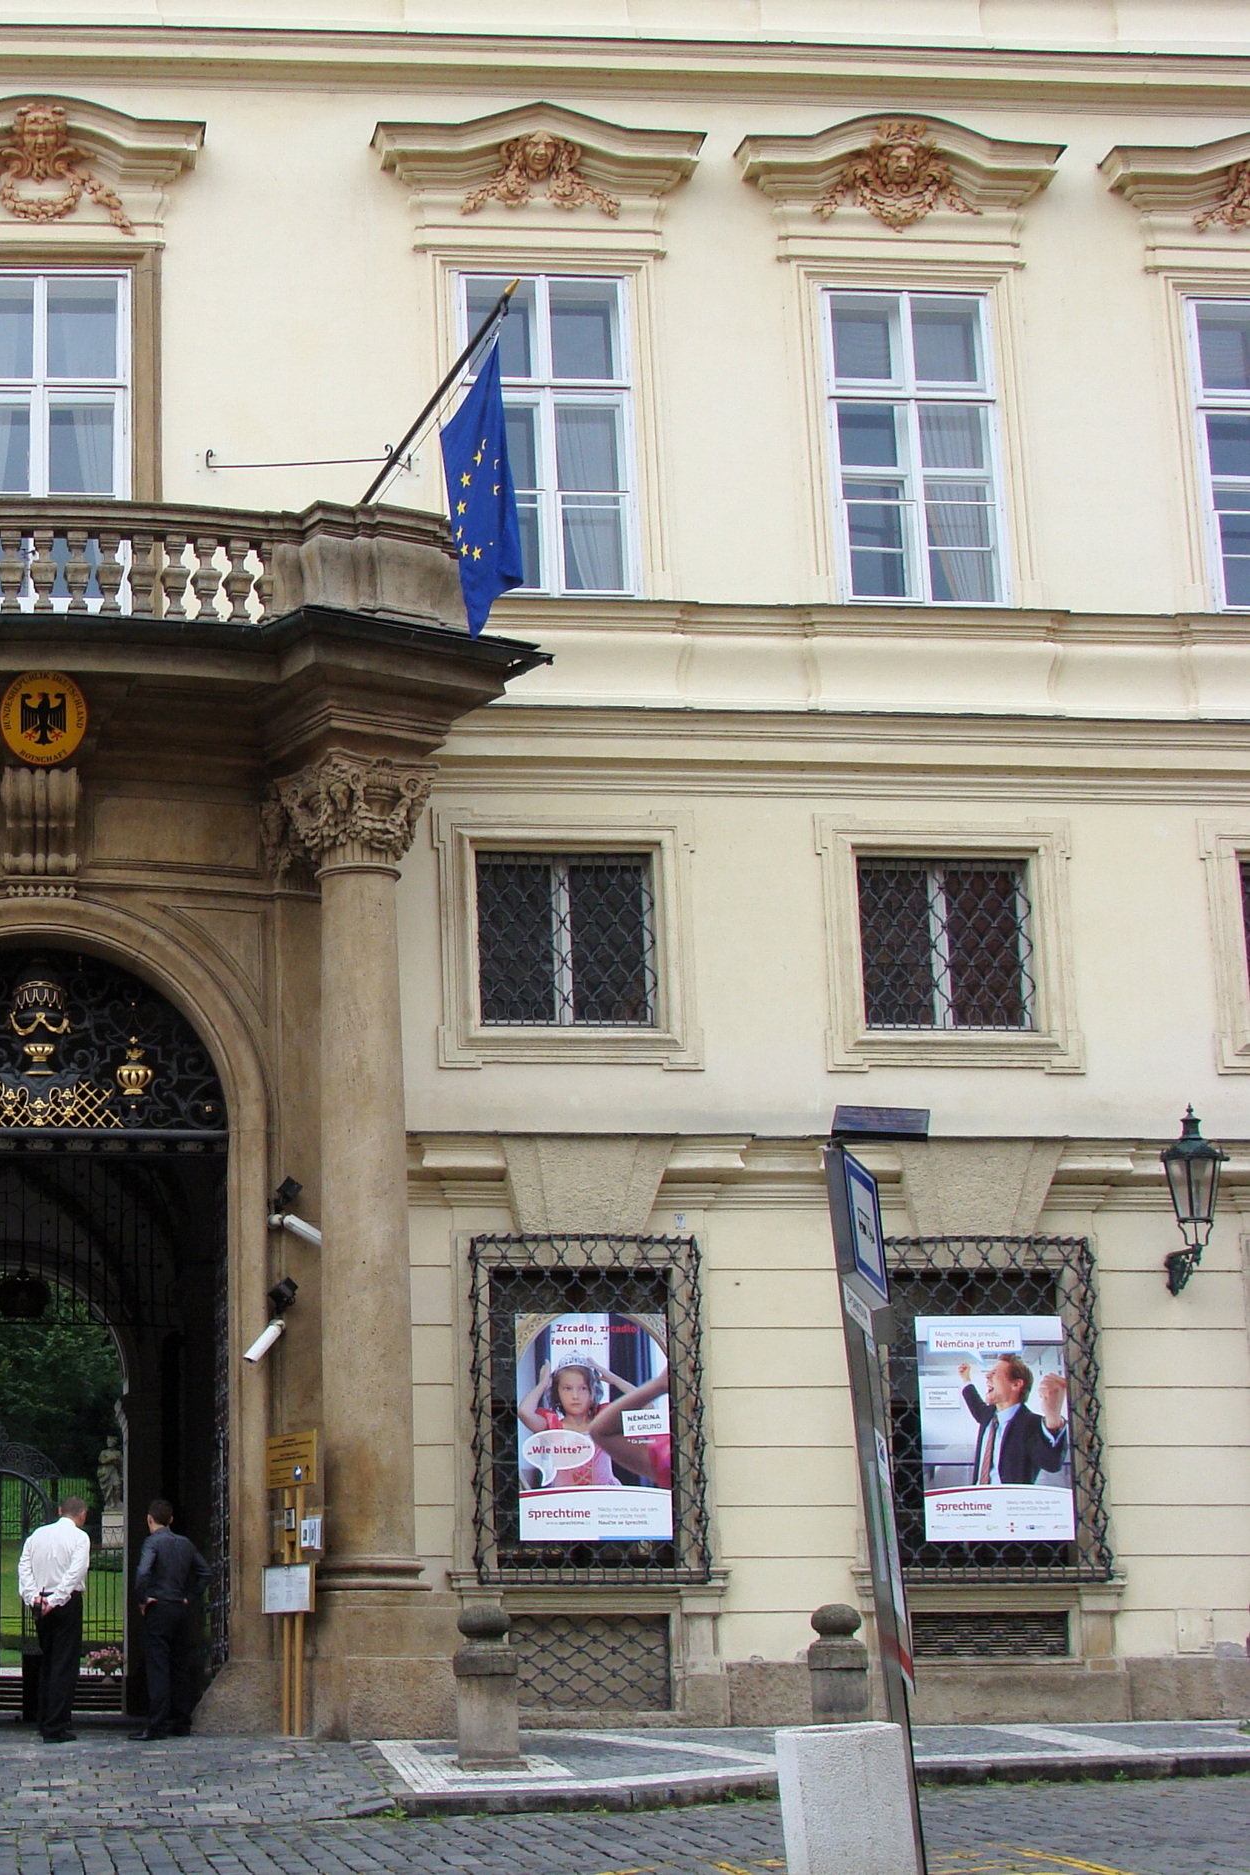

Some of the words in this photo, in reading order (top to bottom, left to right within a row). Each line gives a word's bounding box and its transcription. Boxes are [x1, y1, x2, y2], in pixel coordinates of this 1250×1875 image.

[2, 672, 50, 730] BUNDESREPUBLIK
[52, 674, 85, 729] DEUTSCHLAND
[19, 749, 68, 763] BOTSCHAFT
[551, 1337, 577, 1346] řekni
[935, 1340, 974, 1348] Němčina
[976, 1340, 985, 1349] je
[987, 1339, 1015, 1348] trumf!
[627, 1413, 660, 1422] NĚMČINA
[637, 1423, 662, 1431] GRUND
